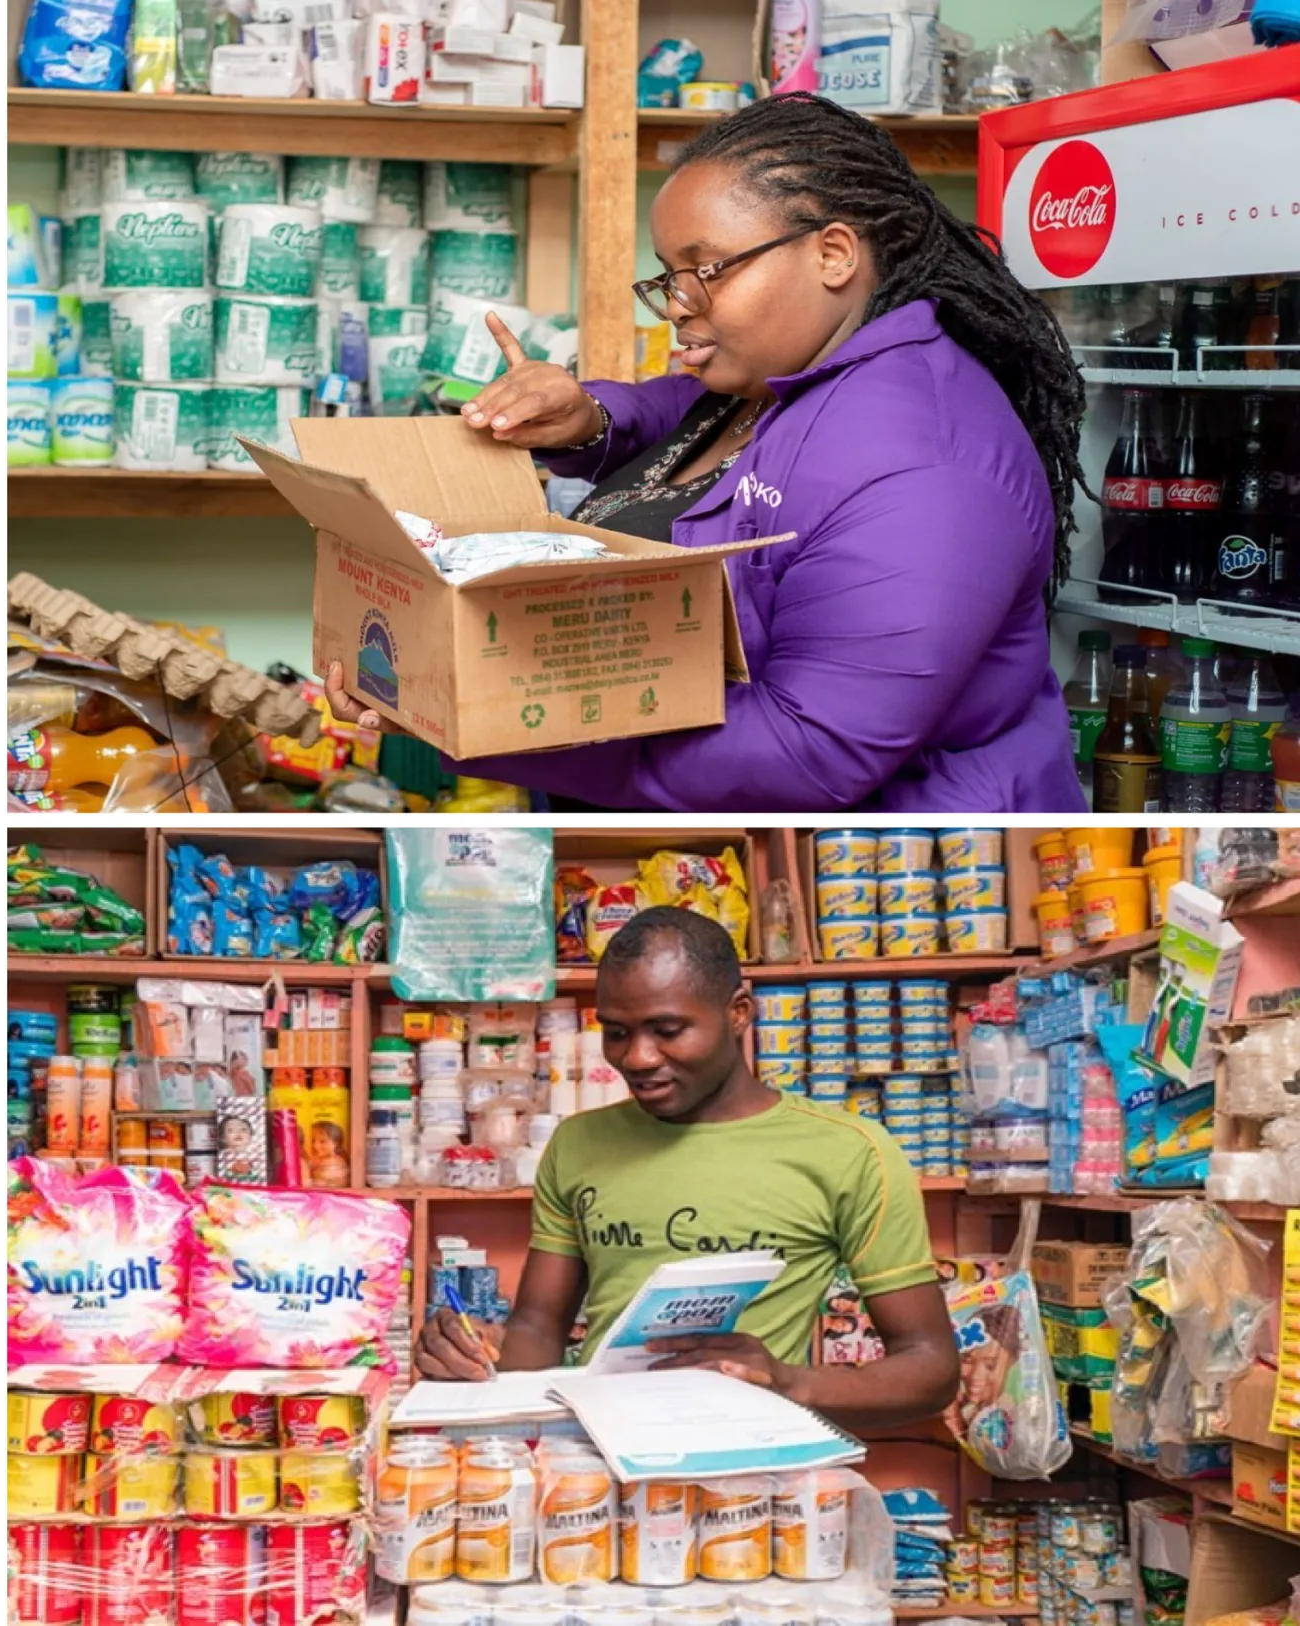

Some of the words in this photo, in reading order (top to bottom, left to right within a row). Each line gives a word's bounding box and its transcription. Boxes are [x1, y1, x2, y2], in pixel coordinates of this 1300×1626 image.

[1033, 184, 1113, 232] Coca-Cola
[1162, 212, 1204, 229] ICE
[1228, 201, 1300, 222] COLD
[117, 212, 202, 247] Neptune
[338, 557, 374, 587] MOUNT
[376, 575, 412, 607] KENYA
[524, 597, 586, 615] PROCESSED
[552, 611, 590, 629] MERU
[593, 607, 633, 624] DAIRY
[21, 1255, 162, 1300] Sunlight
[231, 1258, 369, 1305] Sunlight
[72, 1295, 107, 1311] 2in1
[665, 1294, 736, 1311] mom
